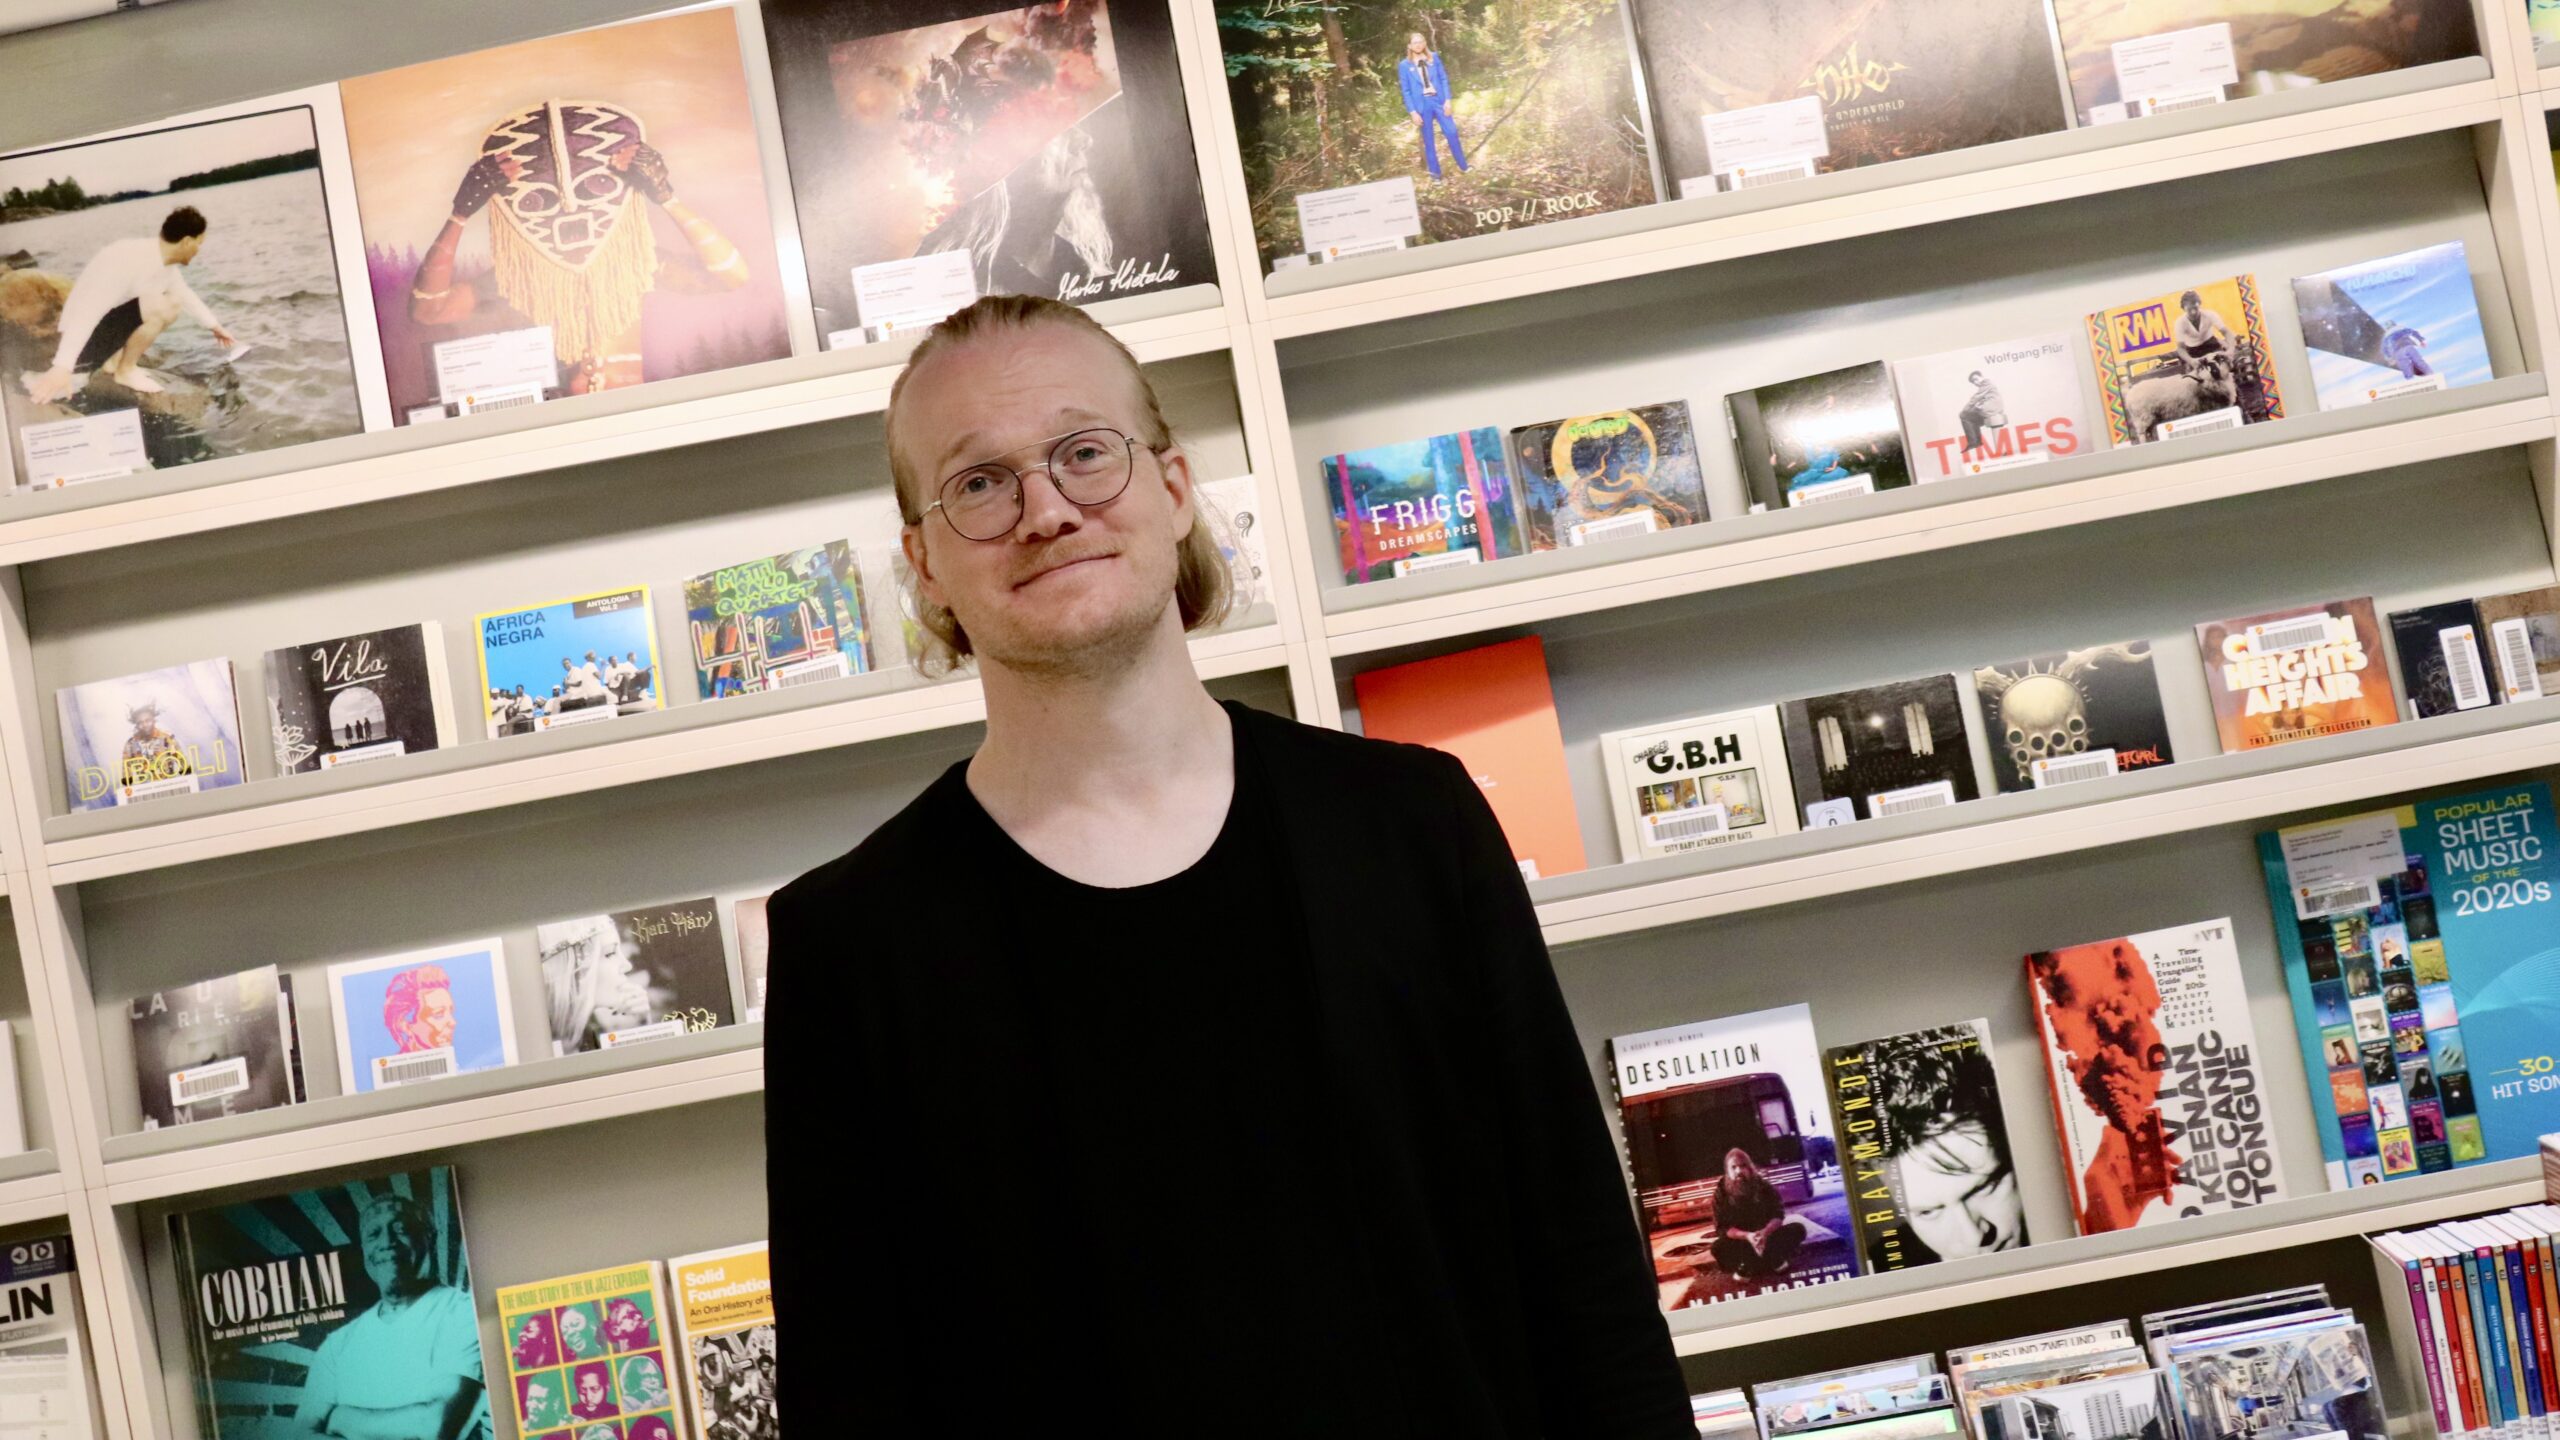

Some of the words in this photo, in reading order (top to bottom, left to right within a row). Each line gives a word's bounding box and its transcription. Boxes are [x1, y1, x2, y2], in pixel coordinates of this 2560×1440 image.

[1475, 206, 1514, 228] POP
[1543, 190, 1601, 217] ROCK
[2114, 306, 2171, 351] RAM
[1984, 348, 2040, 365] Wolfgang
[2041, 343, 2064, 355] Flür
[1925, 417, 2079, 476] TIMES
[1369, 489, 1476, 536] FRIGG
[1379, 523, 1478, 551] DREAMSCAPES
[586, 595, 630, 608] ANTOLOGIA
[486, 627, 545, 648] NEGRA
[312, 639, 388, 682] Vila
[2222, 641, 2369, 692] HEIGHTS
[2244, 672, 2365, 717] AFFAIR
[2249, 734, 2265, 746] THE
[2268, 727, 2318, 743] DEFINITIVE
[2319, 719, 2372, 734] COLLECTION
[1647, 733, 1742, 774] G.B.H
[2434, 793, 2532, 822] POPULAR
[2438, 808, 2534, 848] SHEET
[1664, 844, 1678, 853] CITY
[1679, 841, 1696, 851] BABY
[1697, 836, 1727, 847] ATTACKED
[1728, 835, 1736, 843] BY
[2443, 836, 2542, 875] MUSIC
[2471, 872, 2490, 884] OF
[2493, 867, 2520, 879] THE
[2452, 878, 2552, 917] 2020s
[2154, 956, 2203, 968] Travelling
[2156, 964, 2204, 978] Evangelist's
[2158, 977, 2181, 986] Guide
[2160, 987, 2177, 995] Late
[2161, 990, 2209, 1003] Century
[2166, 1016, 2215, 1029] Music
[1627, 1043, 1761, 1085] DESOLATION
[2518, 1055, 2554, 1076] 30
[2492, 1080, 2524, 1100] HIT
[1835, 1054, 1895, 1223] RAYMONDE
[2171, 1043, 2227, 1205] KEENAN
[2224, 1044, 2277, 1204] TONGUE
[1882, 1229, 1905, 1270] IMON
[201, 1251, 348, 1328] COBHAM
[501, 1292, 515, 1310] THE
[514, 1288, 538, 1307] INSIDE
[537, 1284, 562, 1303] STORY
[560, 1282, 570, 1299] OF
[569, 1280, 583, 1298] THE
[582, 1278, 595, 1295] UK
[593, 1274, 614, 1293] JAZZ
[612, 1268, 650, 1290] EXPLOSION
[684, 1268, 725, 1287] Solid
[690, 1307, 704, 1318] An
[704, 1303, 725, 1316] Oral
[725, 1299, 754, 1315] History
[754, 1298, 763, 1308] of
[212, 1328, 224, 1340] the
[245, 1322, 258, 1334] and
[294, 1315, 302, 1325] of
